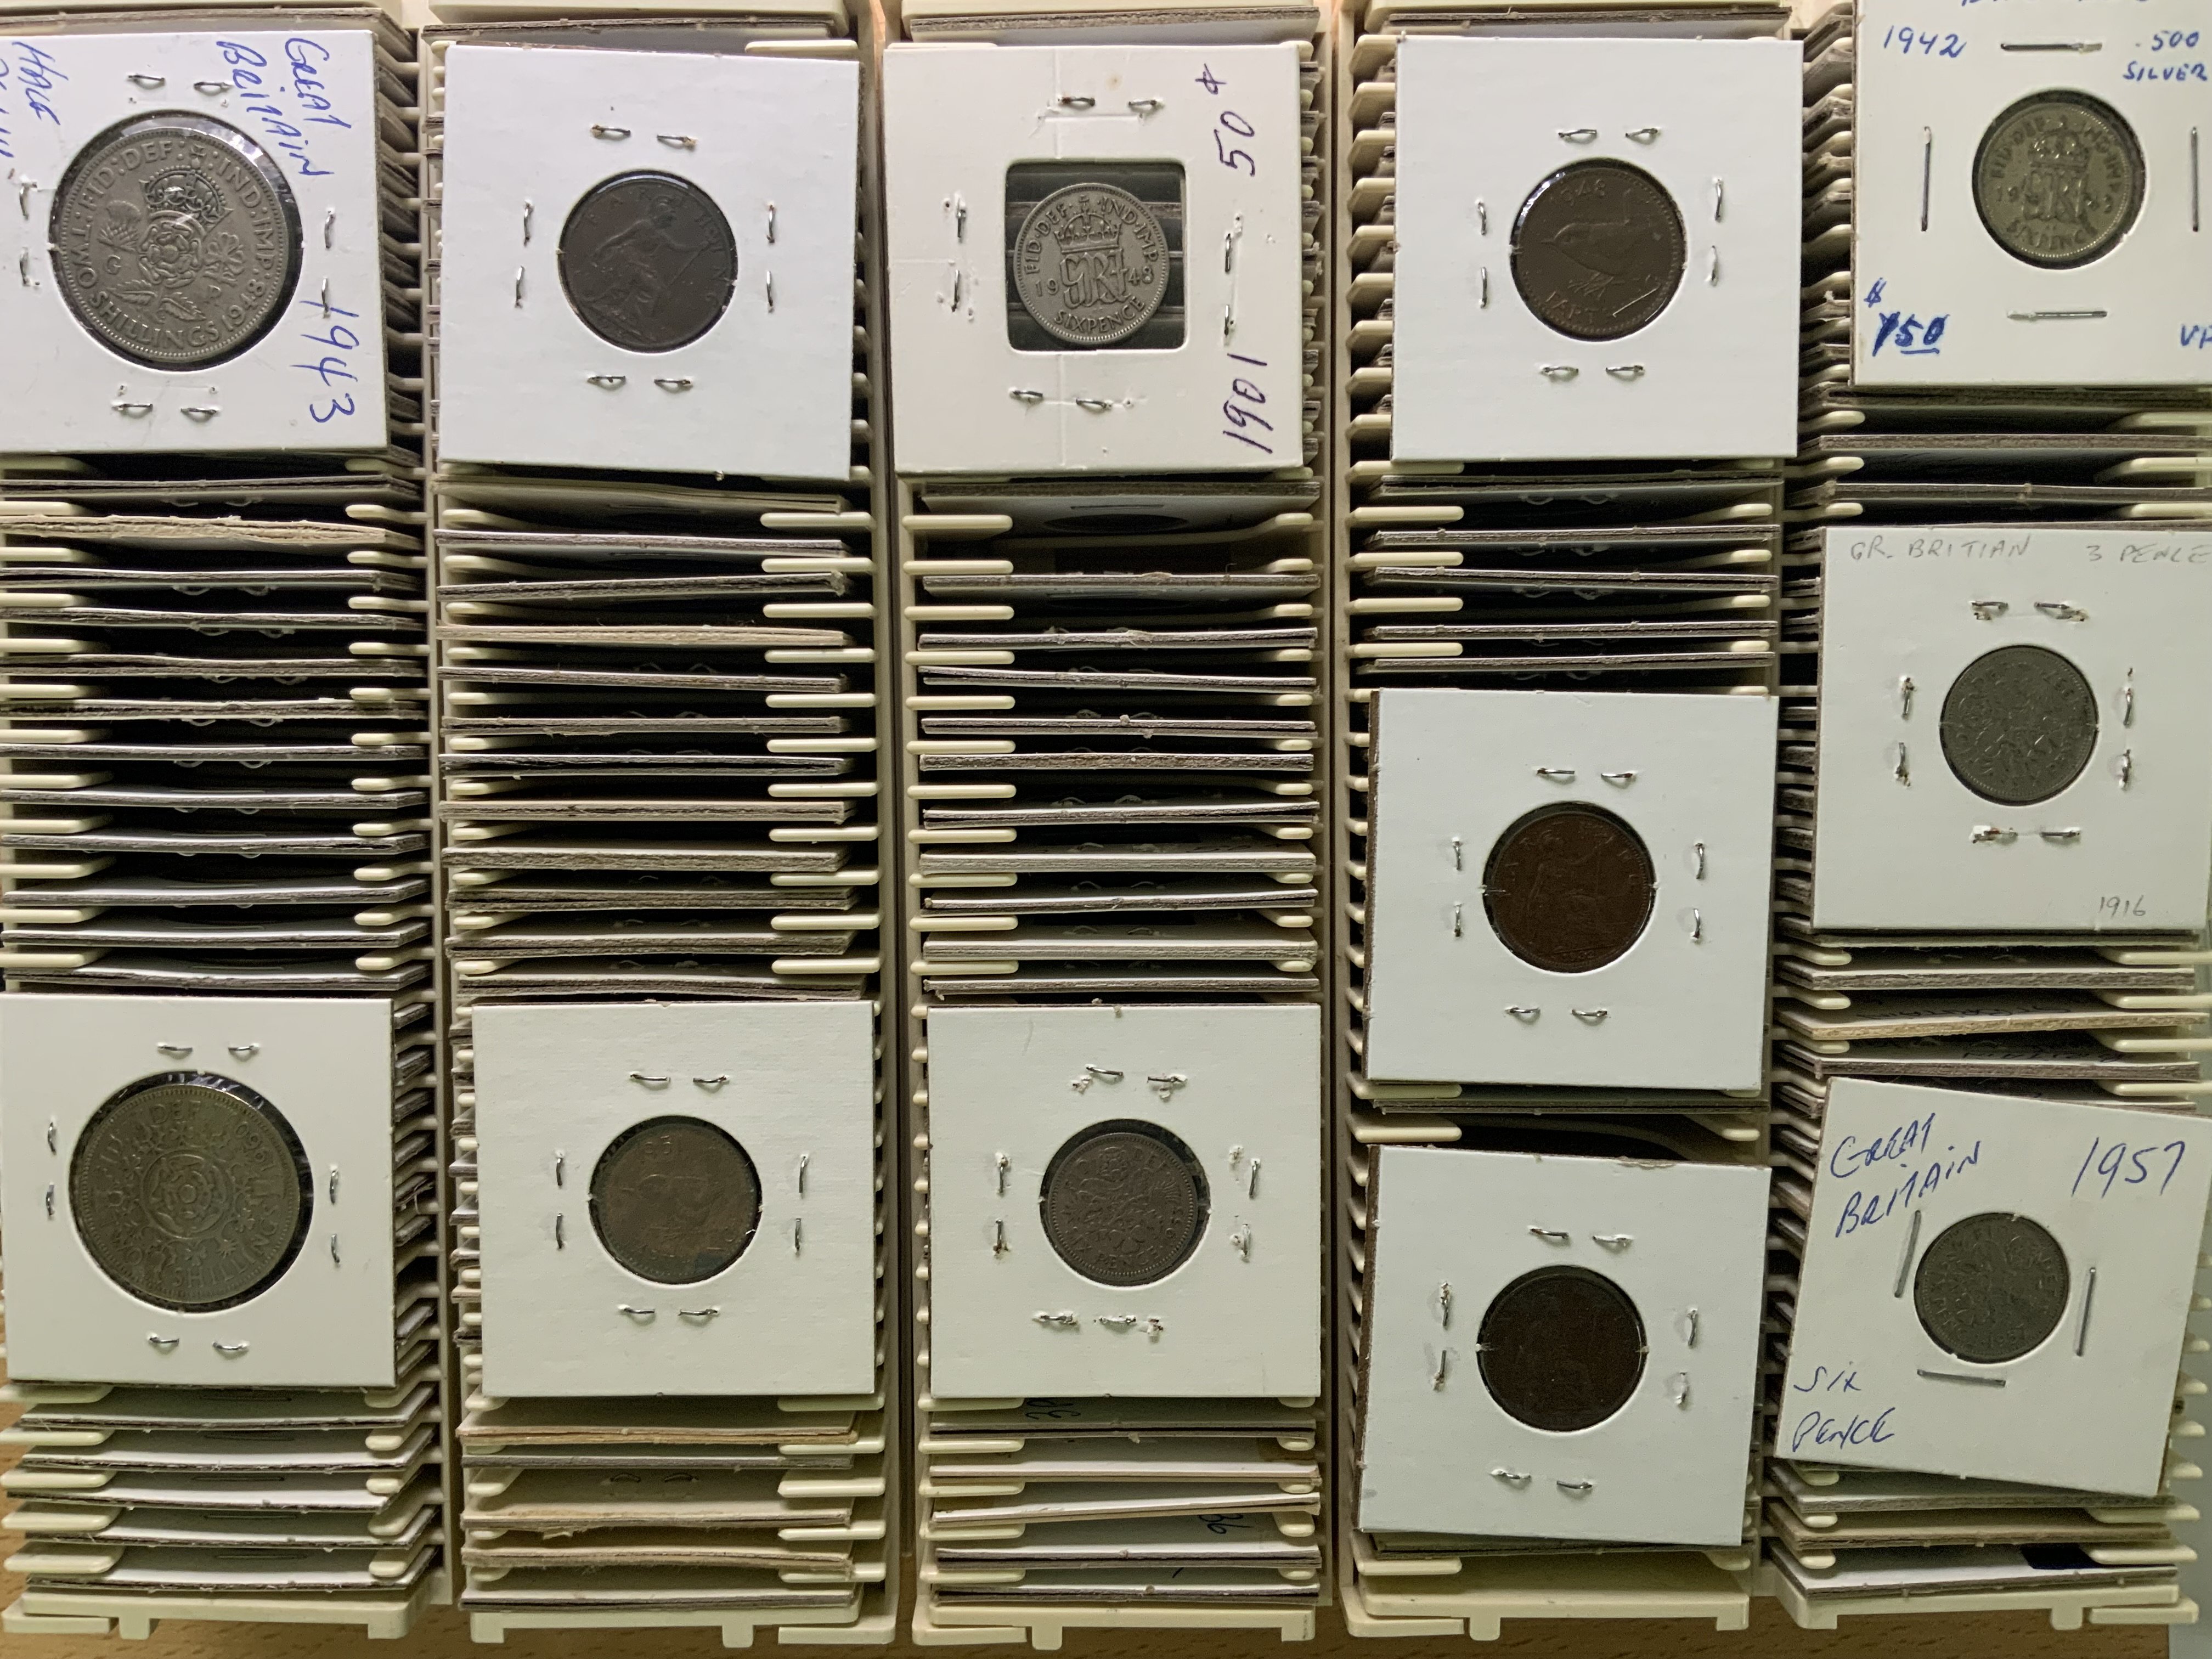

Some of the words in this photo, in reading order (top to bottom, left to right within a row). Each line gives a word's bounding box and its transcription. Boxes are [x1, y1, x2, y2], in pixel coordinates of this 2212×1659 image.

[1883, 26, 1967, 58] 1942
[2123, 61, 2208, 82] SILVER
[71, 226, 98, 290] TWO
[88, 289, 221, 349] SHILLINGS
[1054, 296, 1146, 334] SIXPENCE
[290, 300, 360, 423] 1943
[1223, 353, 1274, 454] 1901
[2086, 545, 2102, 562] 3
[2097, 895, 2146, 920] 1916
[2070, 1136, 2186, 1199] 1957
[1792, 1406, 1896, 1453] PENCE
